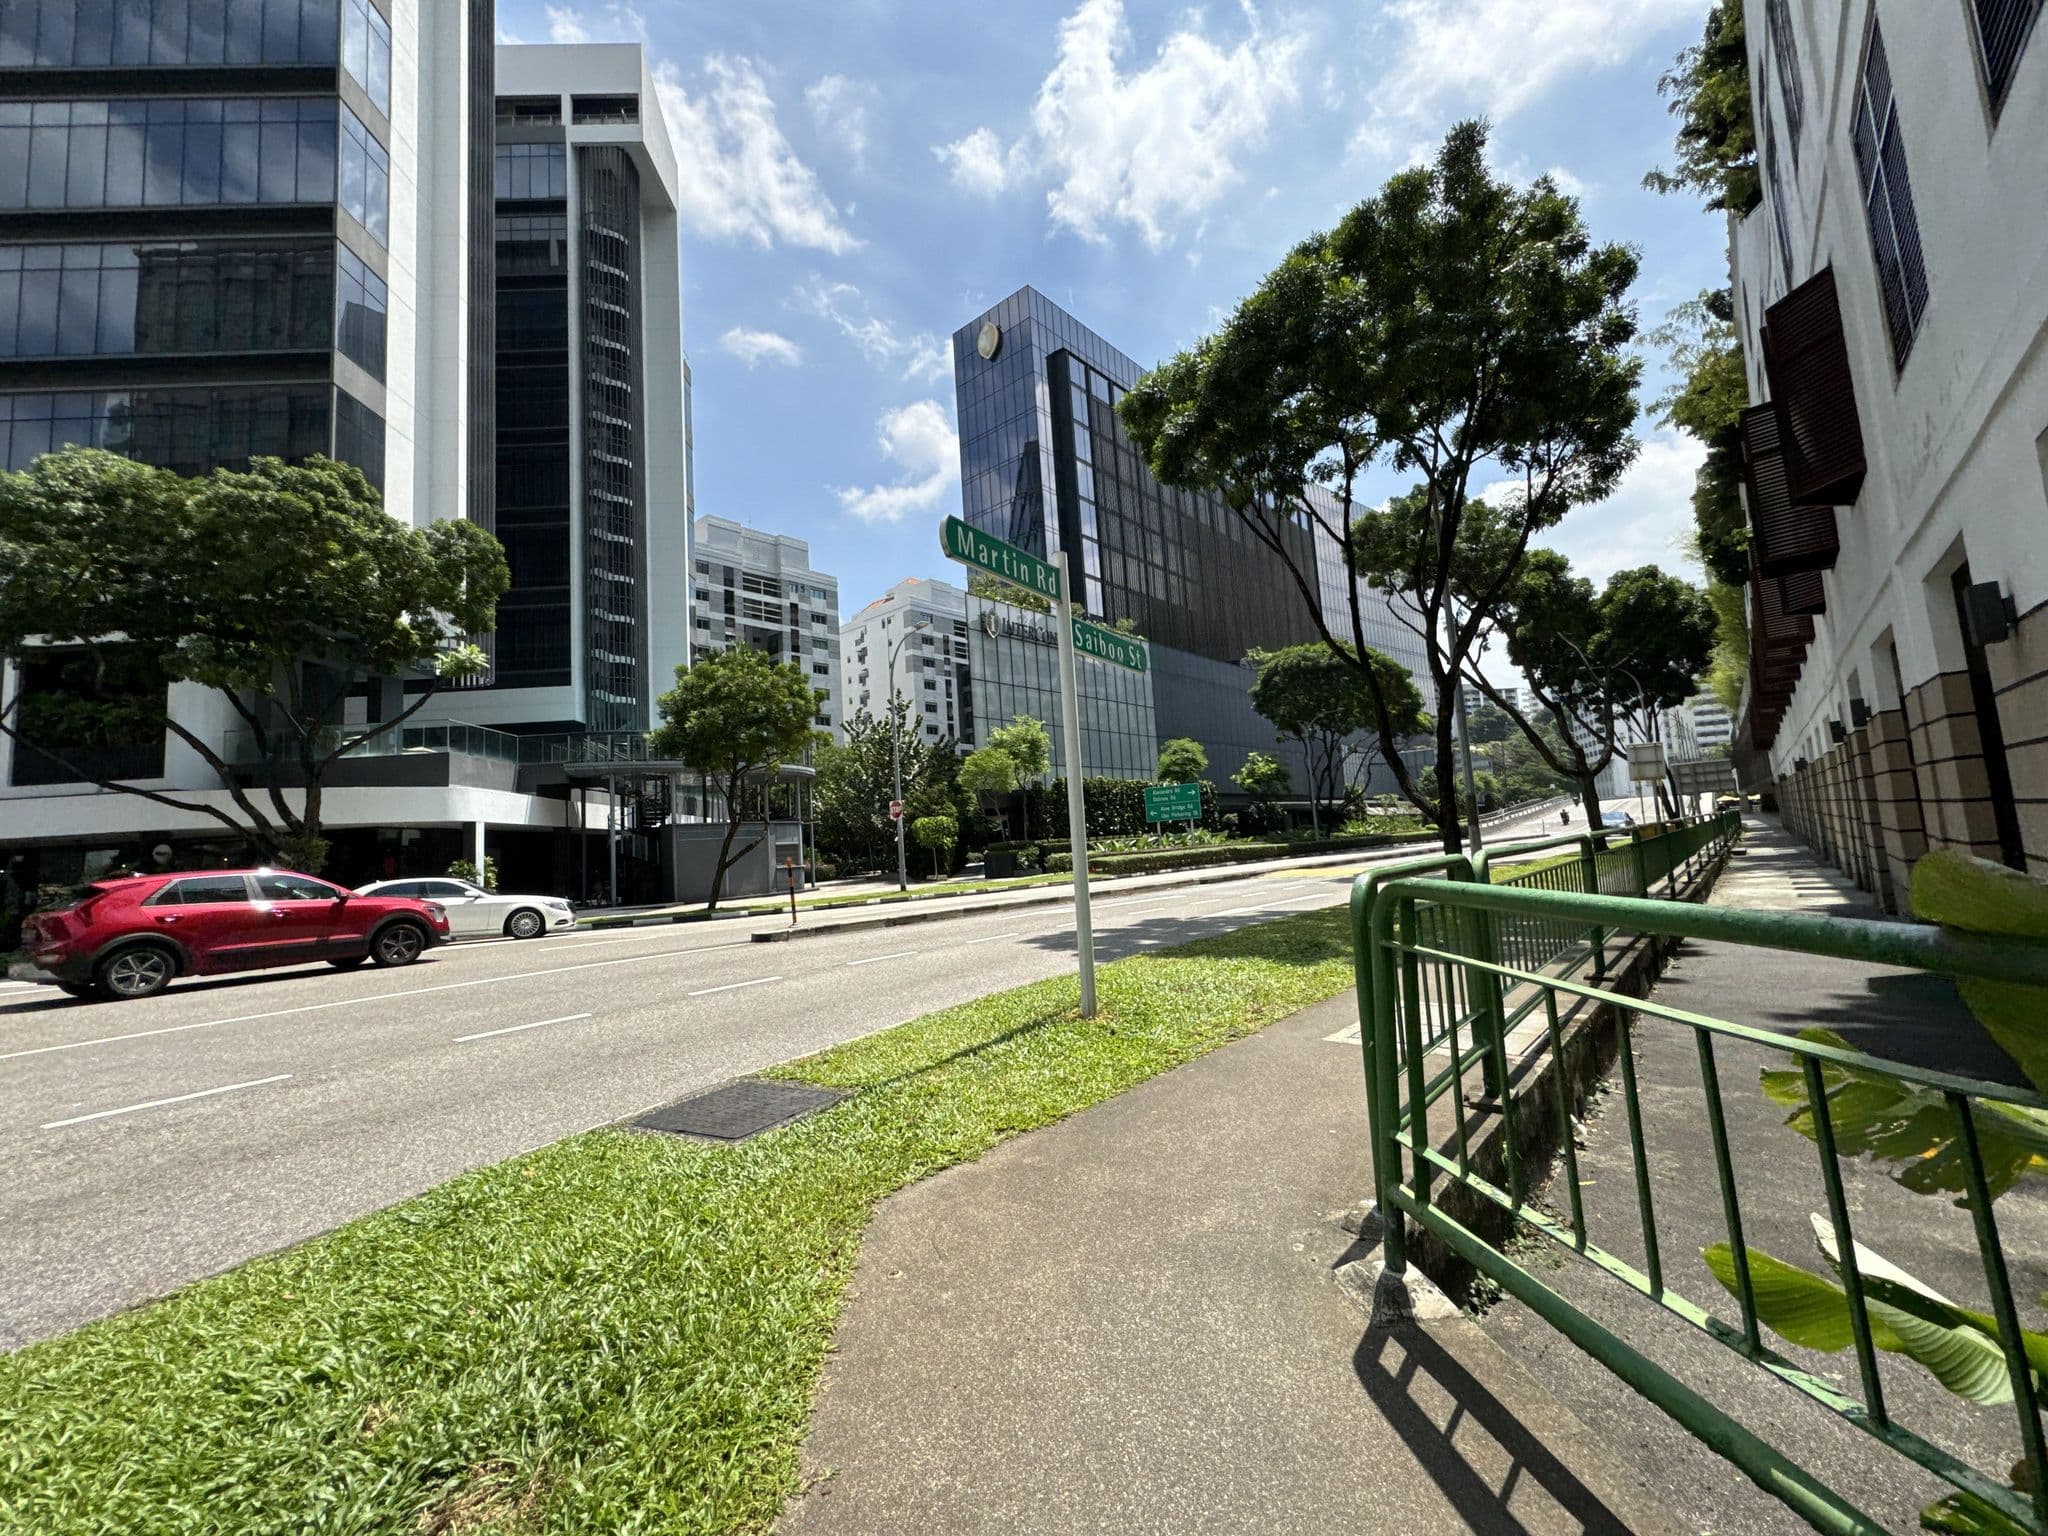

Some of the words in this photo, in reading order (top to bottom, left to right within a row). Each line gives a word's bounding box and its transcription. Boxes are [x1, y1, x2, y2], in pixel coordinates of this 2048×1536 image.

[957, 526, 1029, 584] Martin
[1036, 565, 1056, 595] Rd
[1074, 623, 1124, 660] Saiboo
[1128, 645, 1142, 669] St
